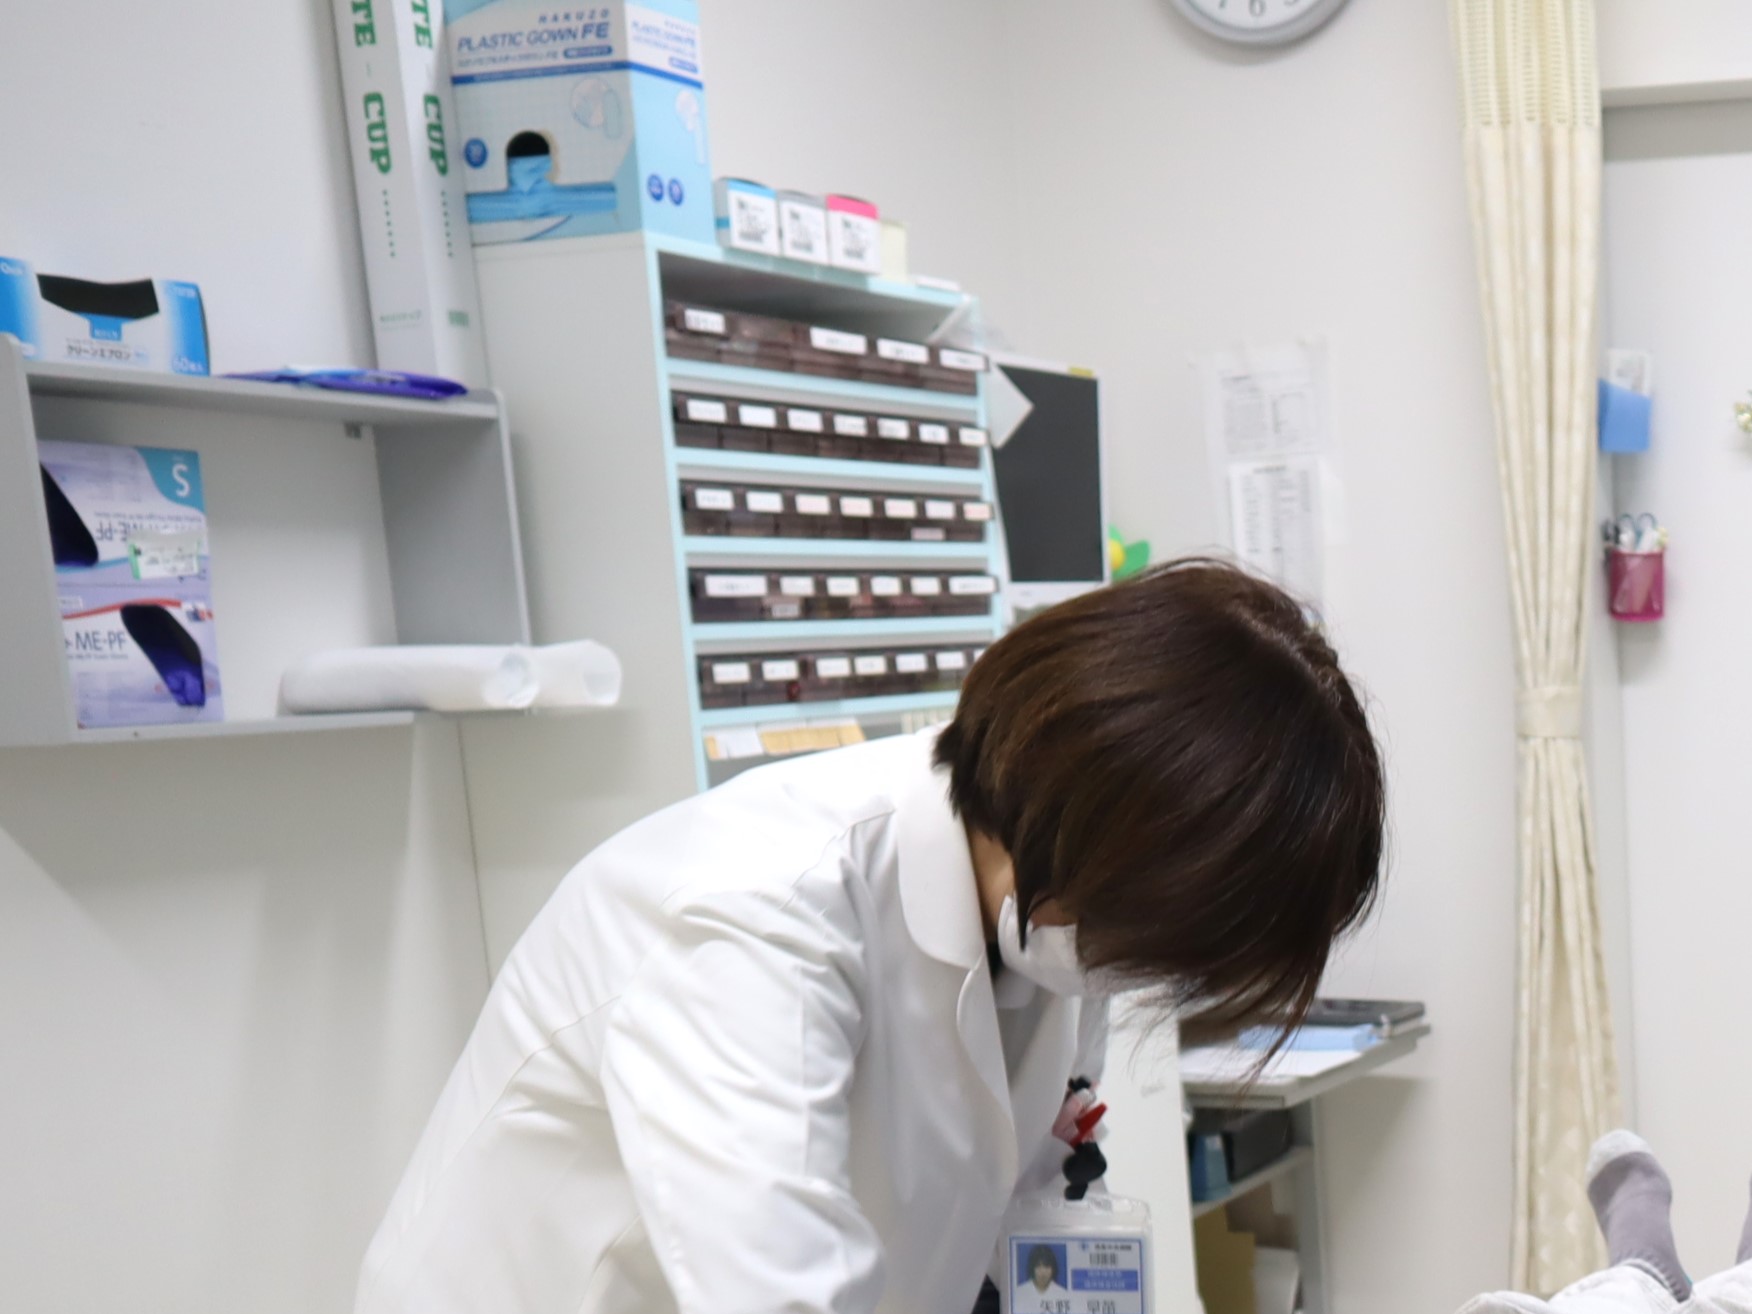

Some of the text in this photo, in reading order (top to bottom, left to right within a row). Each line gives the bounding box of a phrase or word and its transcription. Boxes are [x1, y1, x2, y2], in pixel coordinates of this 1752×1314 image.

[457, 22, 609, 51] PLASTIC GOWN FE
[363, 92, 391, 174] CUP
[423, 93, 448, 177] CUP
[171, 463, 191, 497] S
[75, 630, 126, 651] ME-PF
